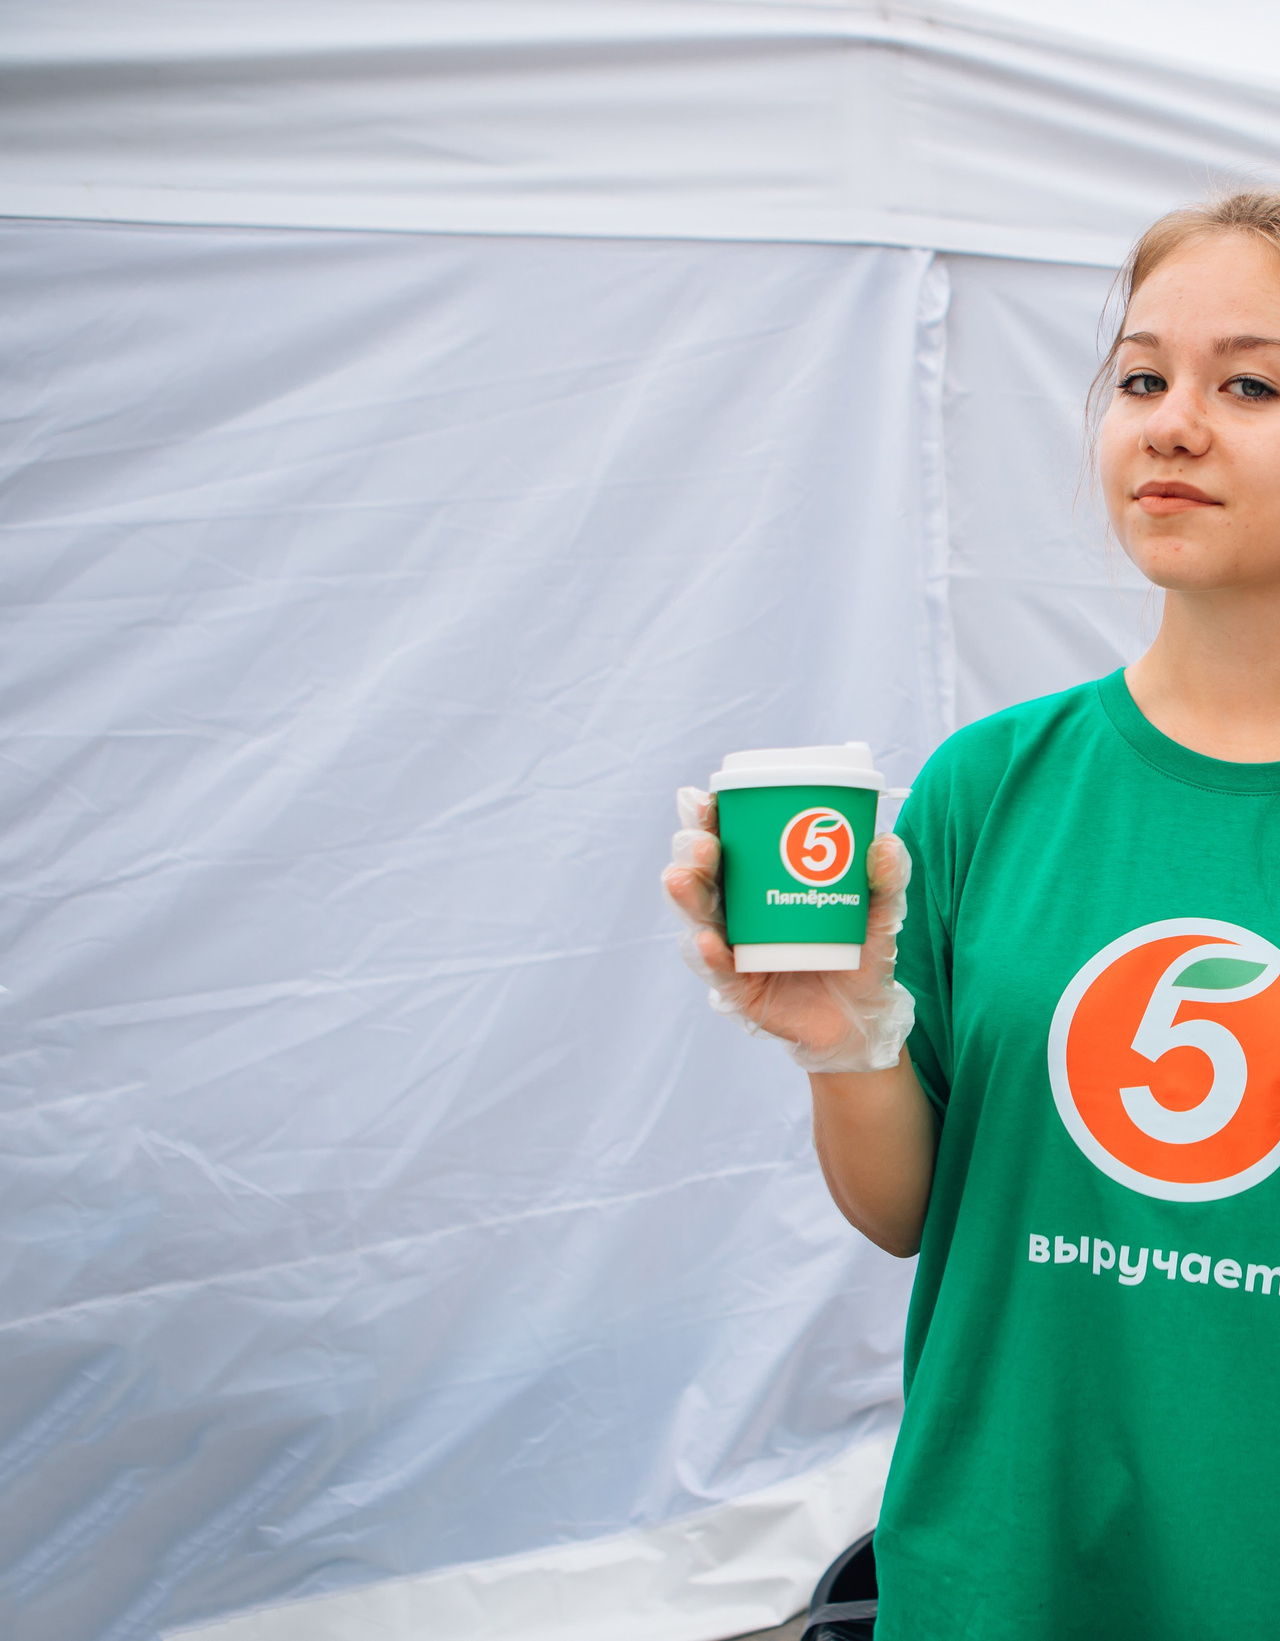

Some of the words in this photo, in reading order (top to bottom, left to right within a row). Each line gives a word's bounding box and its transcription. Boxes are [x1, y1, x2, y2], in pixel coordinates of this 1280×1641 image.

[801, 815, 843, 872] 5
[766, 889, 860, 908] Пятёрочка
[1119, 943, 1280, 1145] 5
